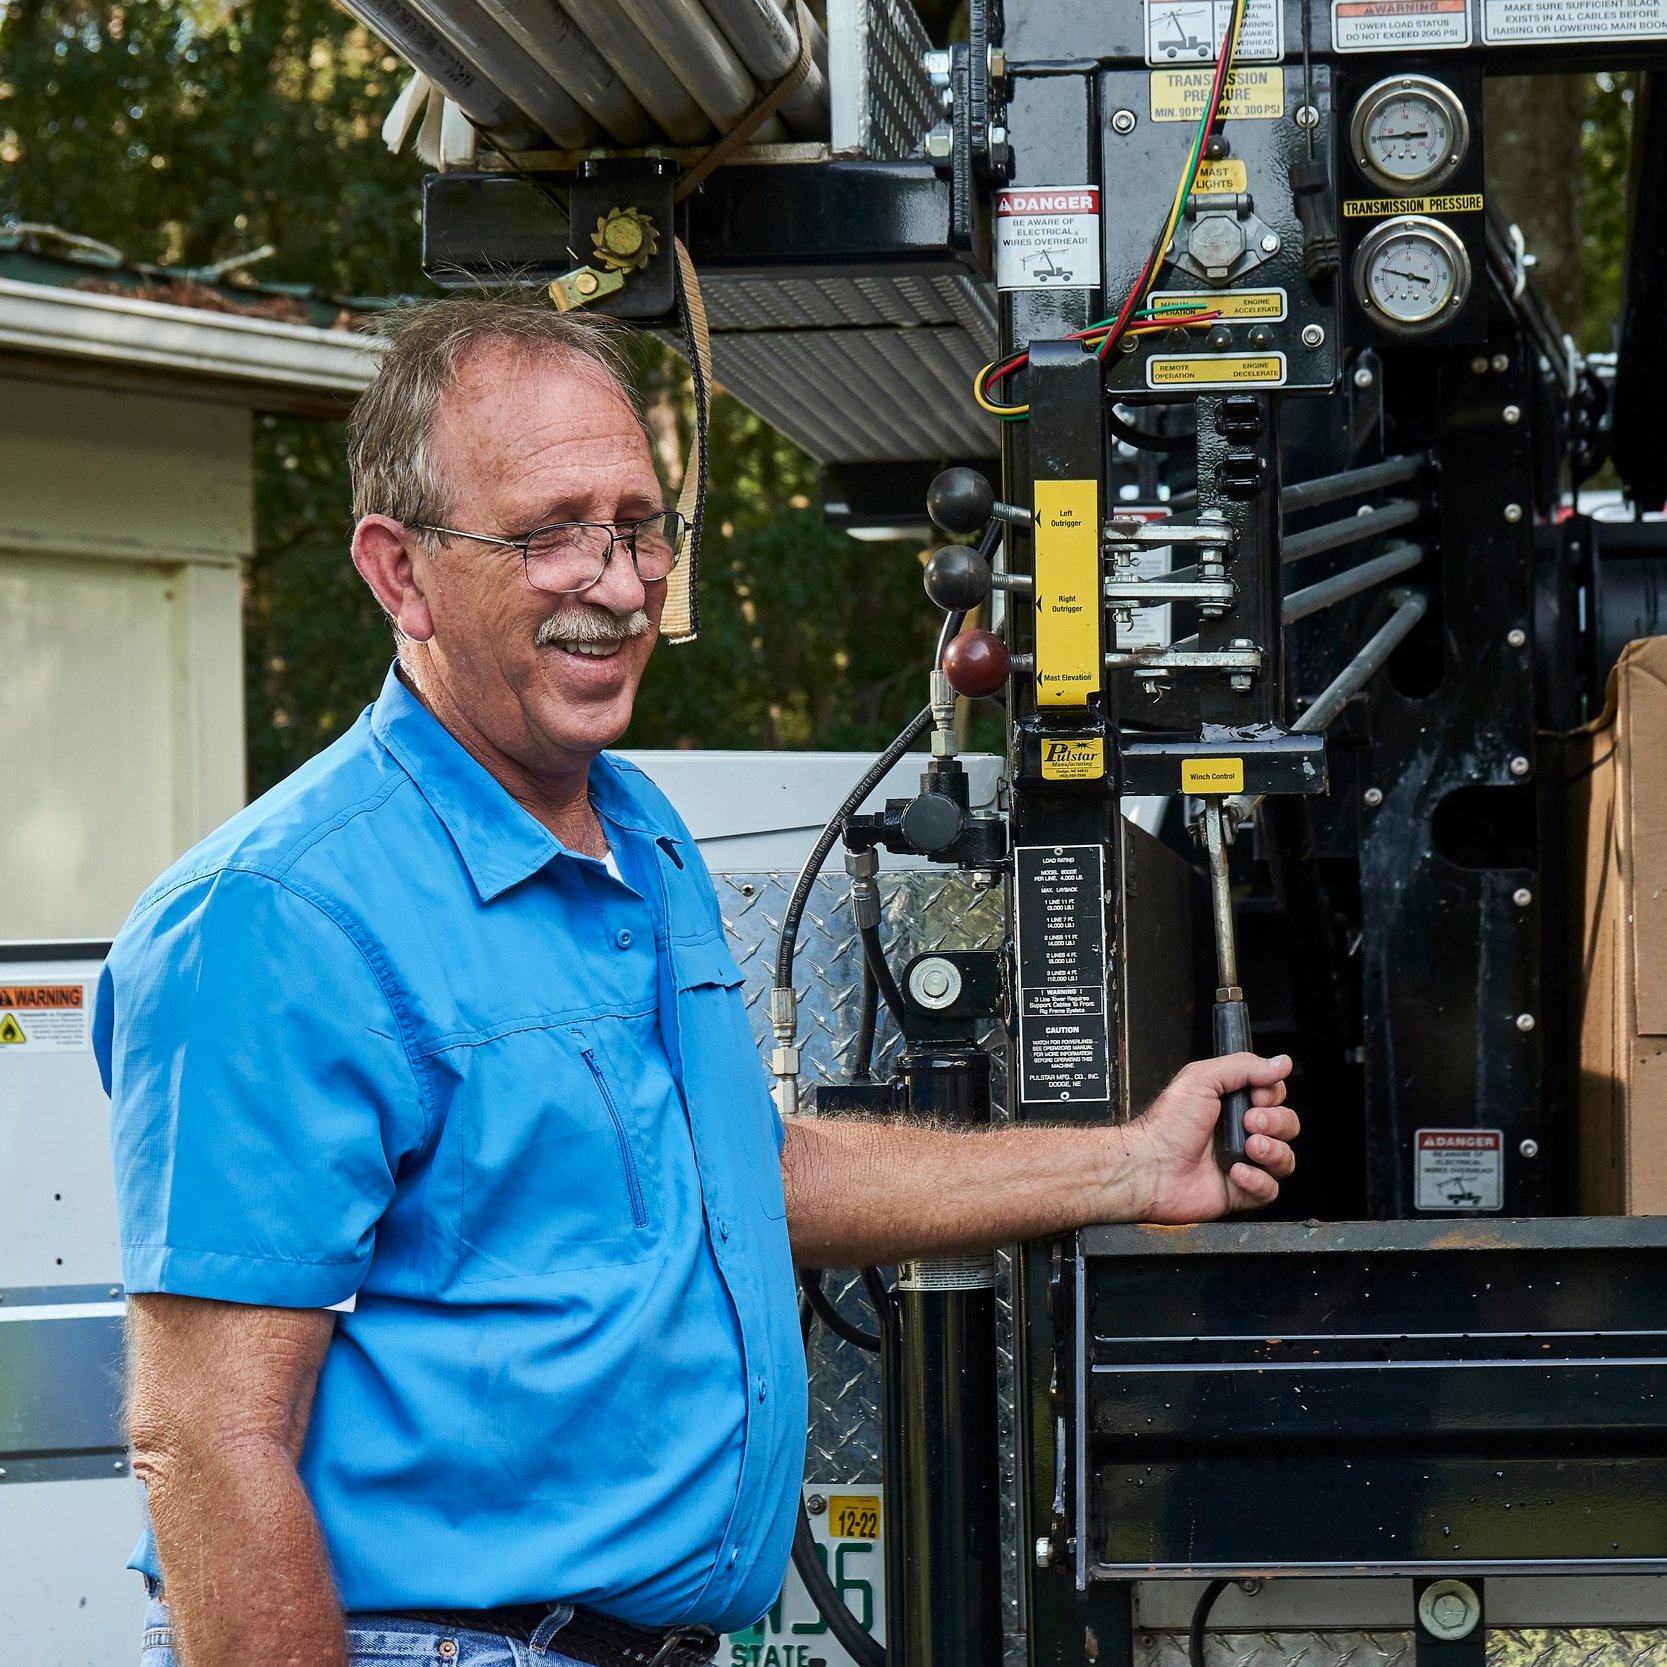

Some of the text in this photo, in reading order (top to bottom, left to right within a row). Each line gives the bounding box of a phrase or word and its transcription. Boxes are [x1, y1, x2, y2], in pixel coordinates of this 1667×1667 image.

[1376, 2, 1439, 14] WARNING
[1504, 3, 1533, 12] MAKE
[1536, 2, 1563, 10] SURE
[1566, 0, 1627, 9] SUFFICIENT
[1506, 14, 1540, 23] EXISTS
[1556, 13, 1574, 21] ALL
[1577, 12, 1617, 20] CABLES
[1620, 10, 1659, 18] BEFORE
[1354, 19, 1449, 30] TOWER LOAD STATUS
[1493, 26, 1533, 35] RAISING
[1554, 24, 1608, 32] LOWERING
[1639, 21, 1667, 29] BOOM
[1383, 31, 1419, 39] EXCEED
[1167, 72, 1268, 87] TRANSISSION
[1155, 104, 1280, 117] MIN. 90 MAX. 300 PSI
[1200, 167, 1229, 176] MAST
[1196, 180, 1233, 189] LIGHTS
[1013, 196, 1093, 210] DANGER
[1345, 196, 1482, 215] TRANSMISSION PRESSURE
[1027, 218, 1059, 226] AWARE
[1017, 228, 1072, 236] ELECTRICAL
[1003, 237, 1088, 246] WIRES OVERHEAD!
[1051, 520, 1082, 528] Outrigger
[1058, 595, 1076, 603] Right
[1052, 605, 1083, 613] Outrigger
[1062, 673, 1092, 681] Elevation
[1044, 743, 1098, 762] Pulstar
[781, 940, 791, 964] Flame
[15, 989, 80, 1006] WARNING
[1046, 1026, 1079, 1034] CAUTION
[1437, 1137, 1494, 1147] DANGER
[731, 1645, 810, 1667] STATE
